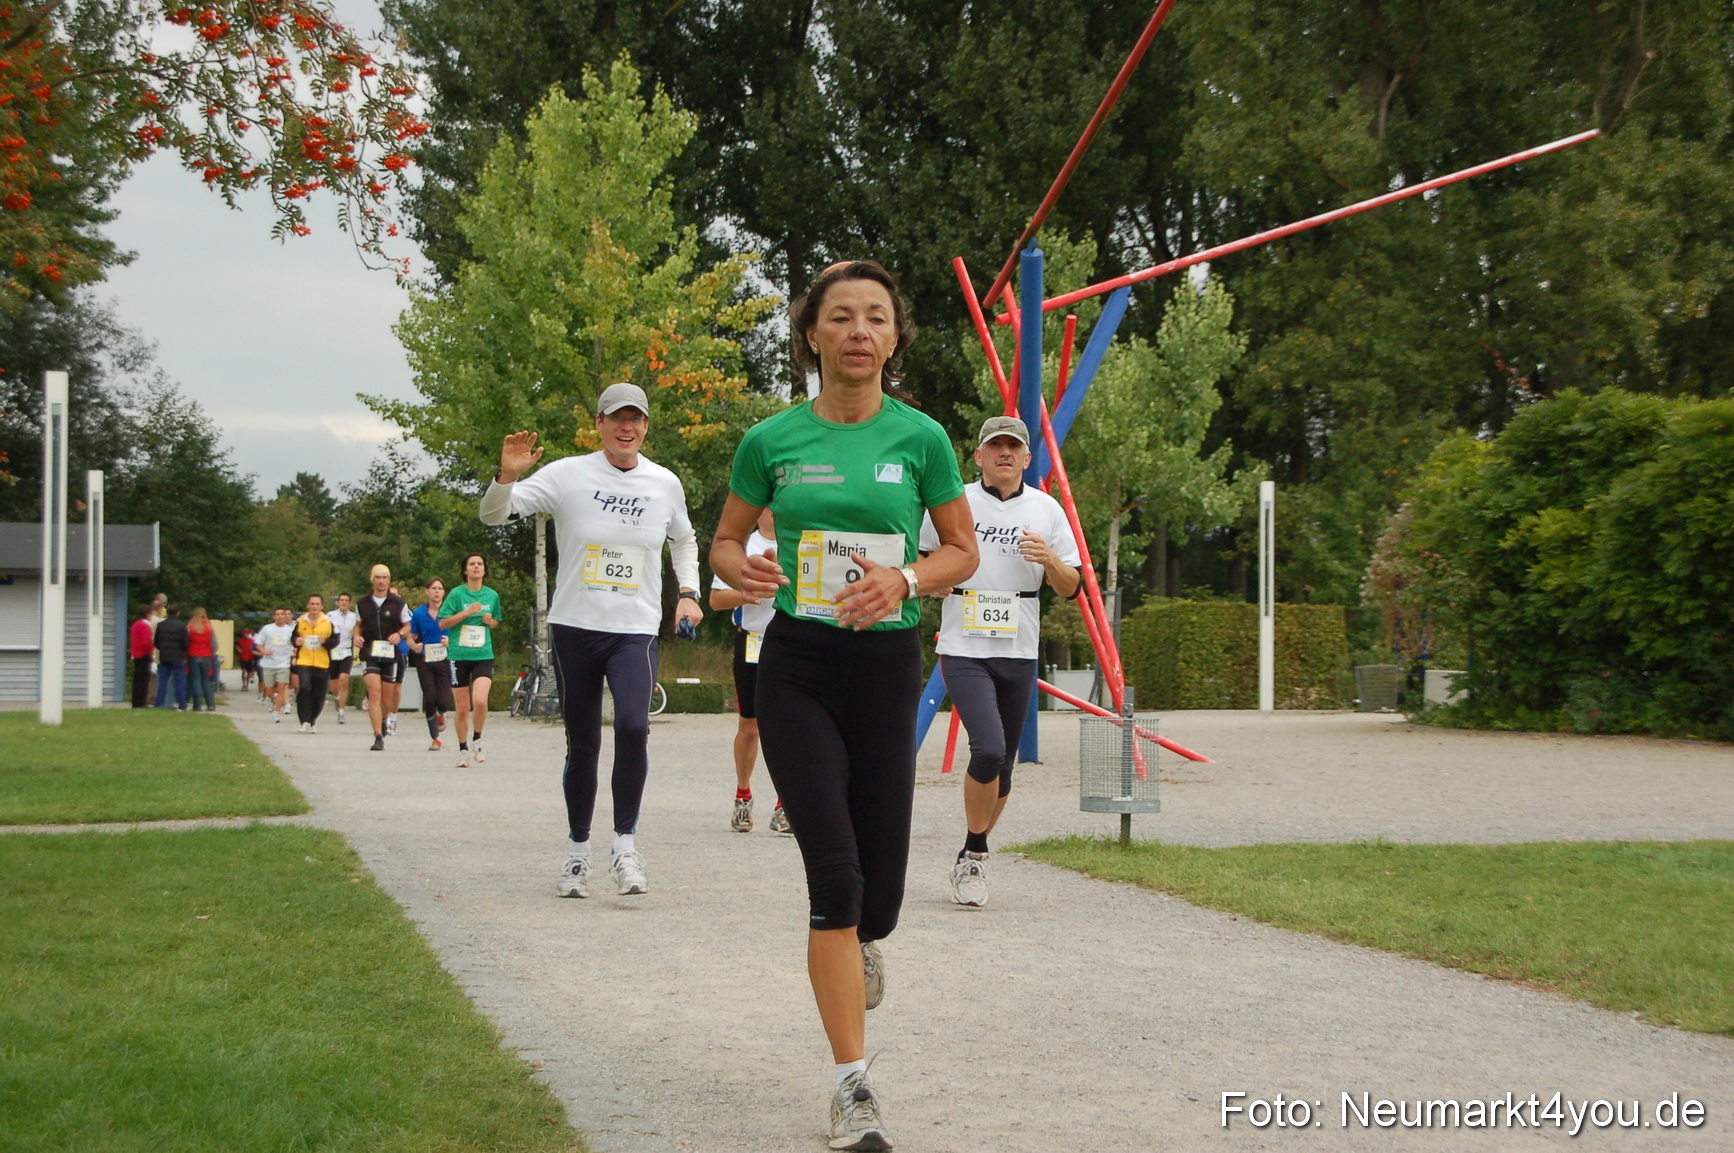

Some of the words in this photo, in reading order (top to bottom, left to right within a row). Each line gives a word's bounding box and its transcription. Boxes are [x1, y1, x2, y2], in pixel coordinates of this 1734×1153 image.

[593, 490, 640, 507] Lauf
[600, 500, 646, 518] Treff
[974, 522, 1020, 536] Lauf
[601, 548, 623, 559] Peter
[605, 563, 633, 579] 623
[977, 594, 1012, 605] Christian
[983, 609, 1010, 623] 634
